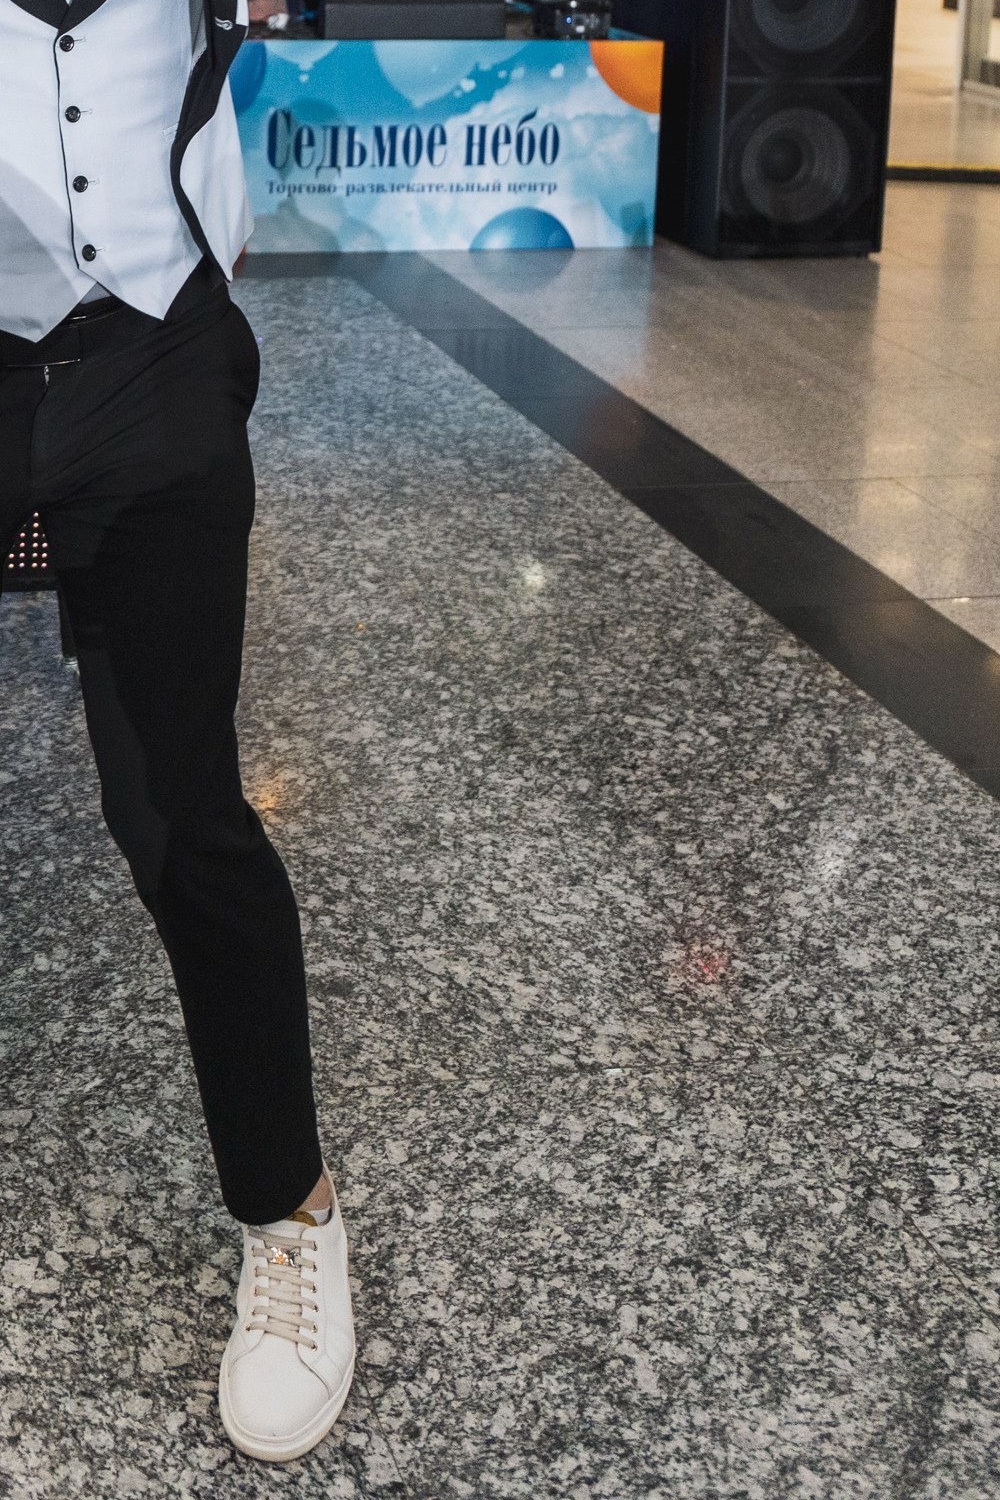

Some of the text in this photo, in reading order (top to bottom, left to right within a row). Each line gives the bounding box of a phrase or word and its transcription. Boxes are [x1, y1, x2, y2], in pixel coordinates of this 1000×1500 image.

[267, 106, 560, 179] Седьмое небо
[507, 181, 558, 195] центр
